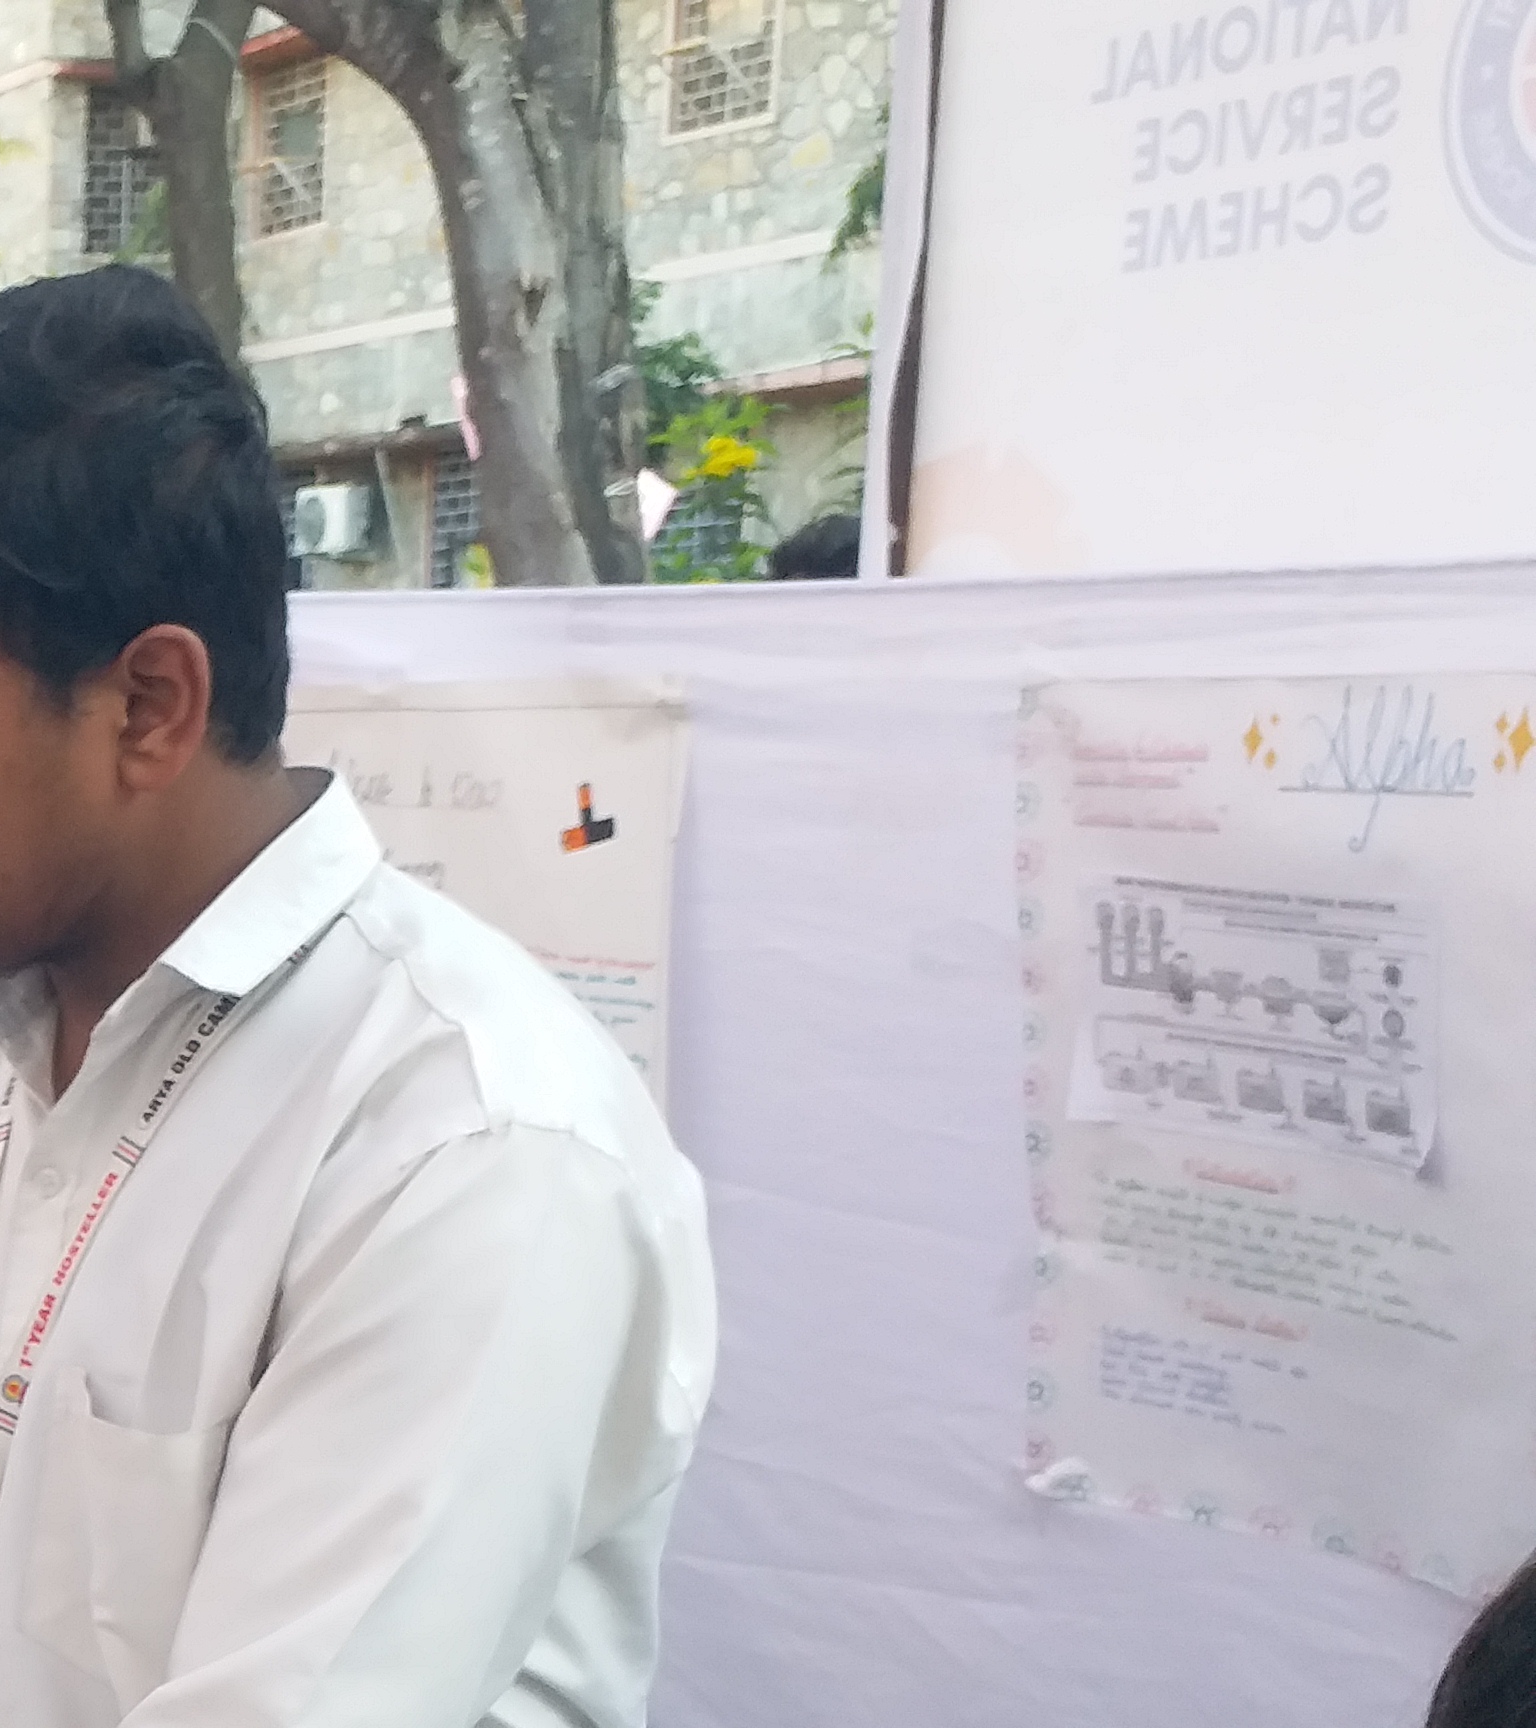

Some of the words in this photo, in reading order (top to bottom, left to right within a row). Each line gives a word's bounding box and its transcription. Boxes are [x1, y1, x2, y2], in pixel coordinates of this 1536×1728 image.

[170, 1039, 202, 1075] OLD
[197, 994, 243, 1037] CAM
[27, 1293, 58, 1349] YEAR
[51, 1171, 119, 1287] HOSTELLER
